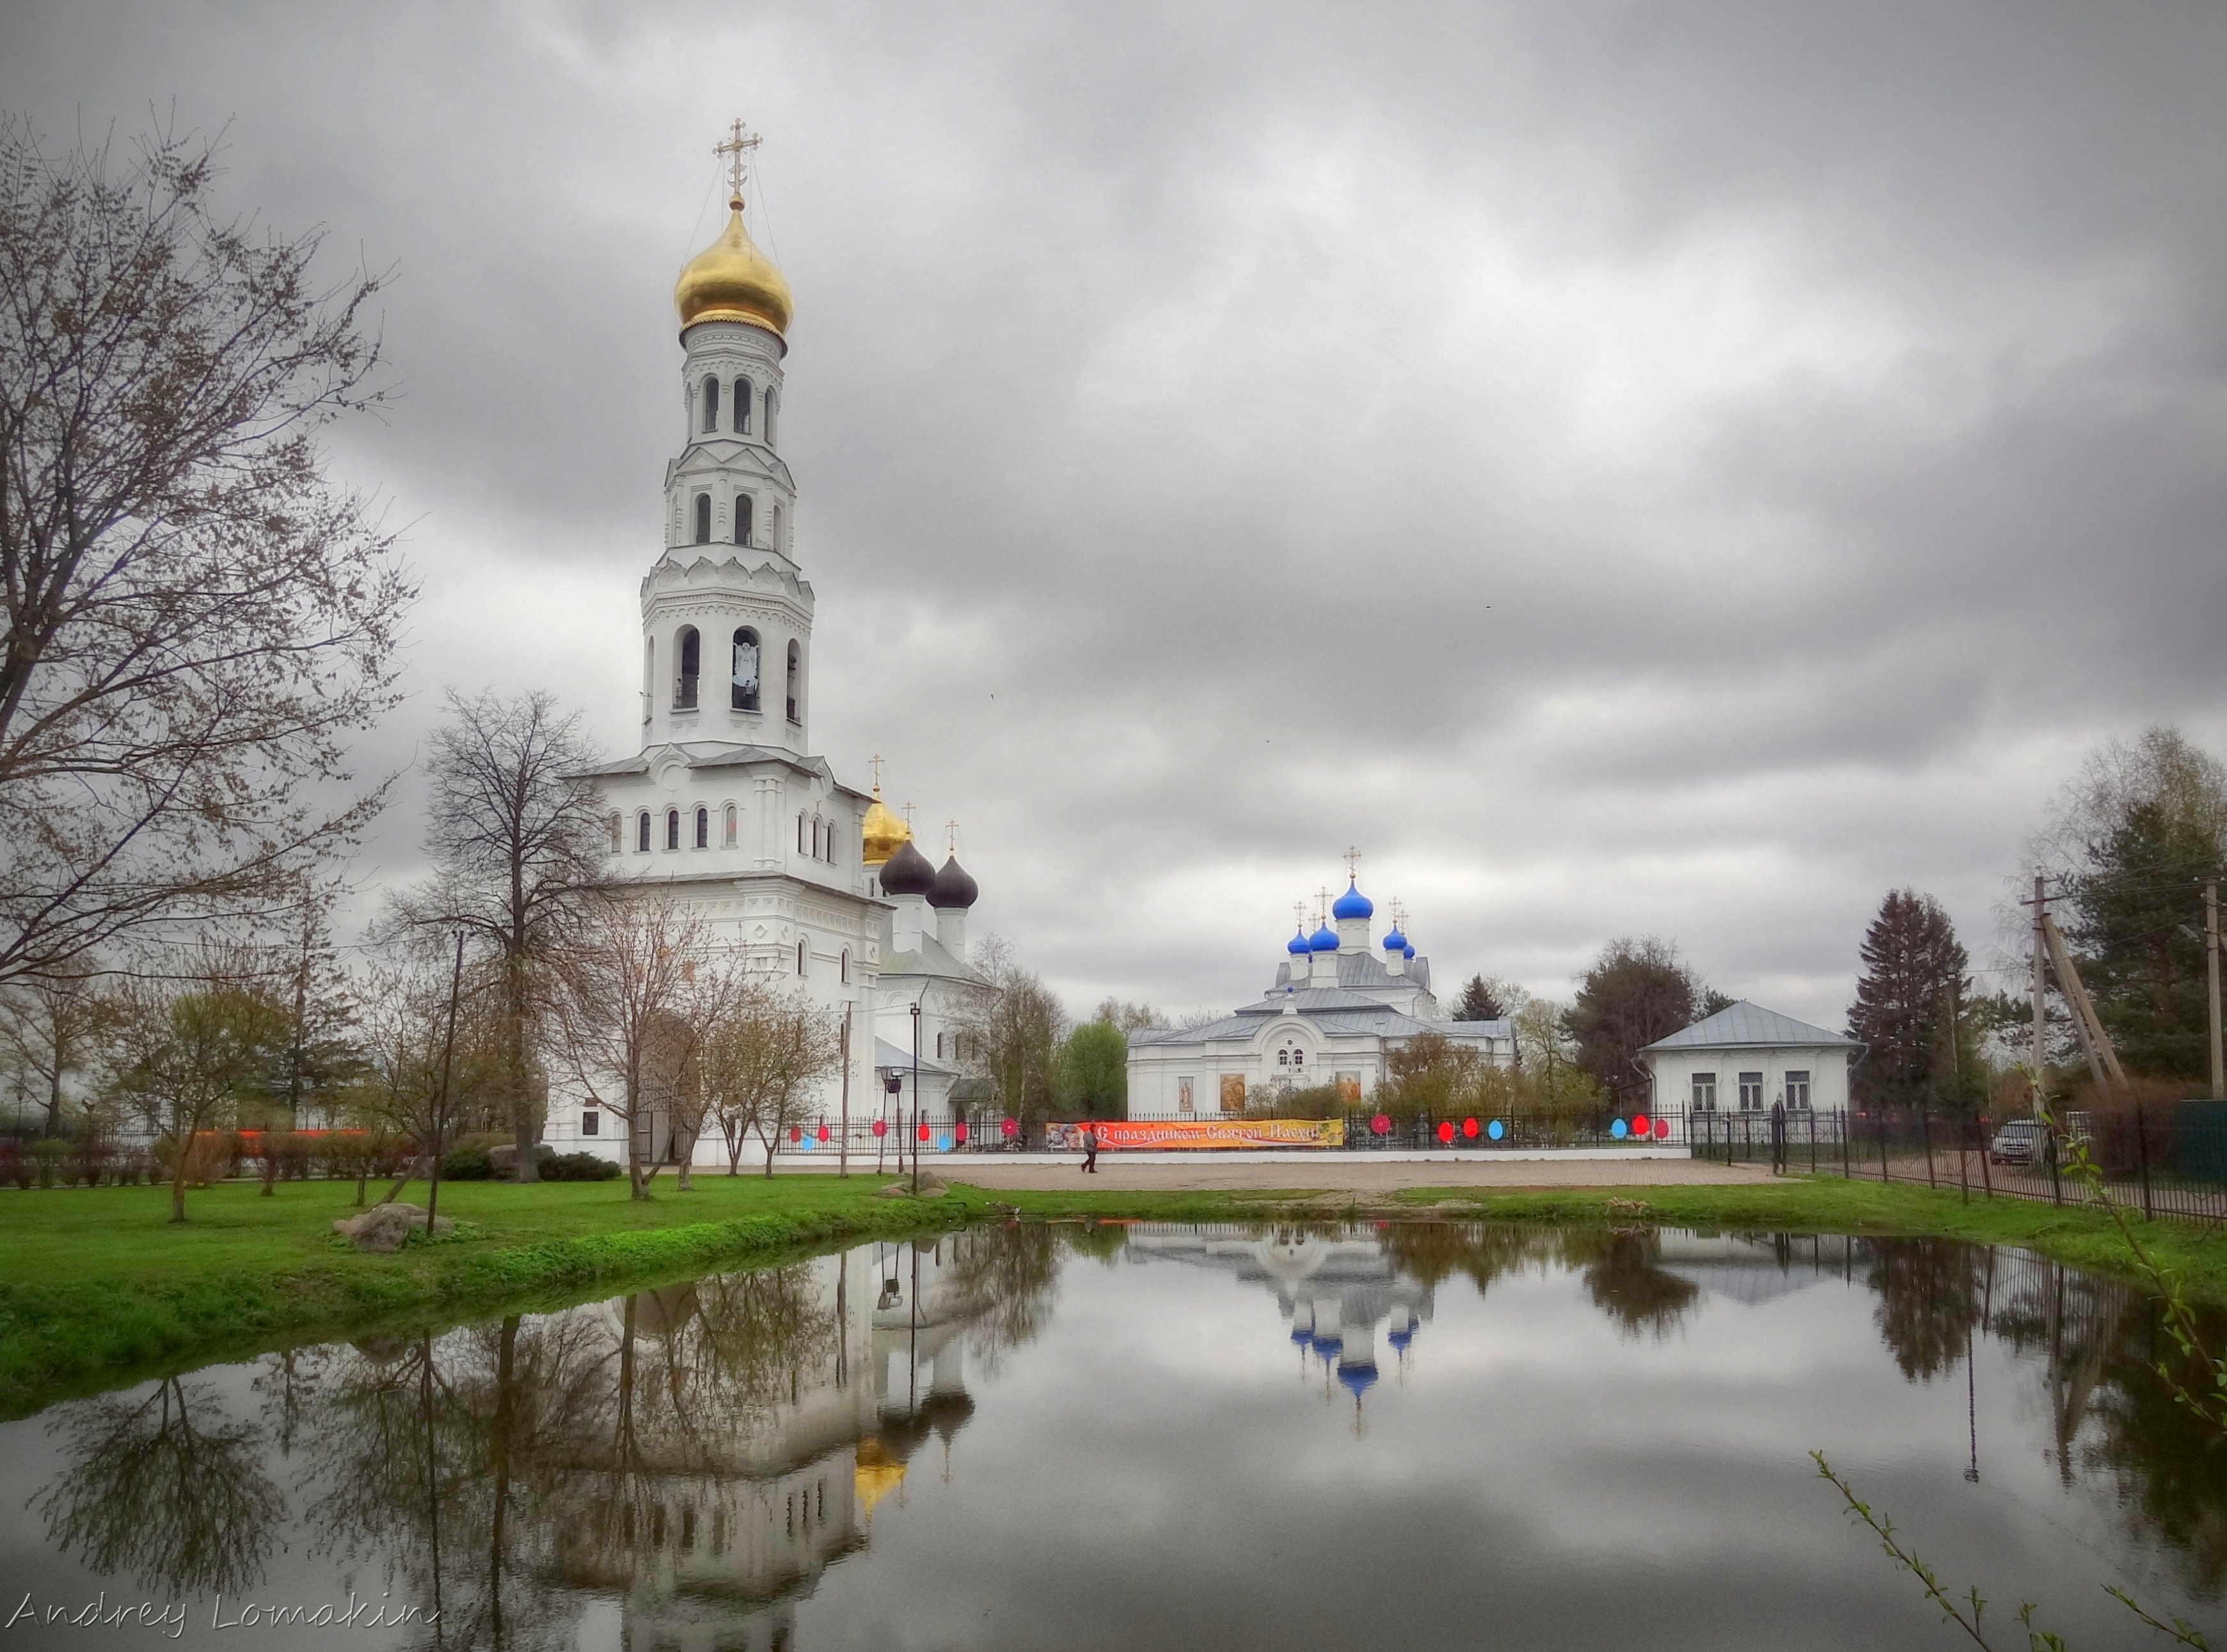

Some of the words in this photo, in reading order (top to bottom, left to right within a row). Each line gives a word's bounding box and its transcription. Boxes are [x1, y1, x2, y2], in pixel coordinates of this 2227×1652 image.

[1097, 1126, 1108, 1140] С
[1114, 1130, 1200, 1143] праздником
[1206, 1125, 1262, 1139] Святой
[1269, 1124, 1319, 1141] Пасхи!
